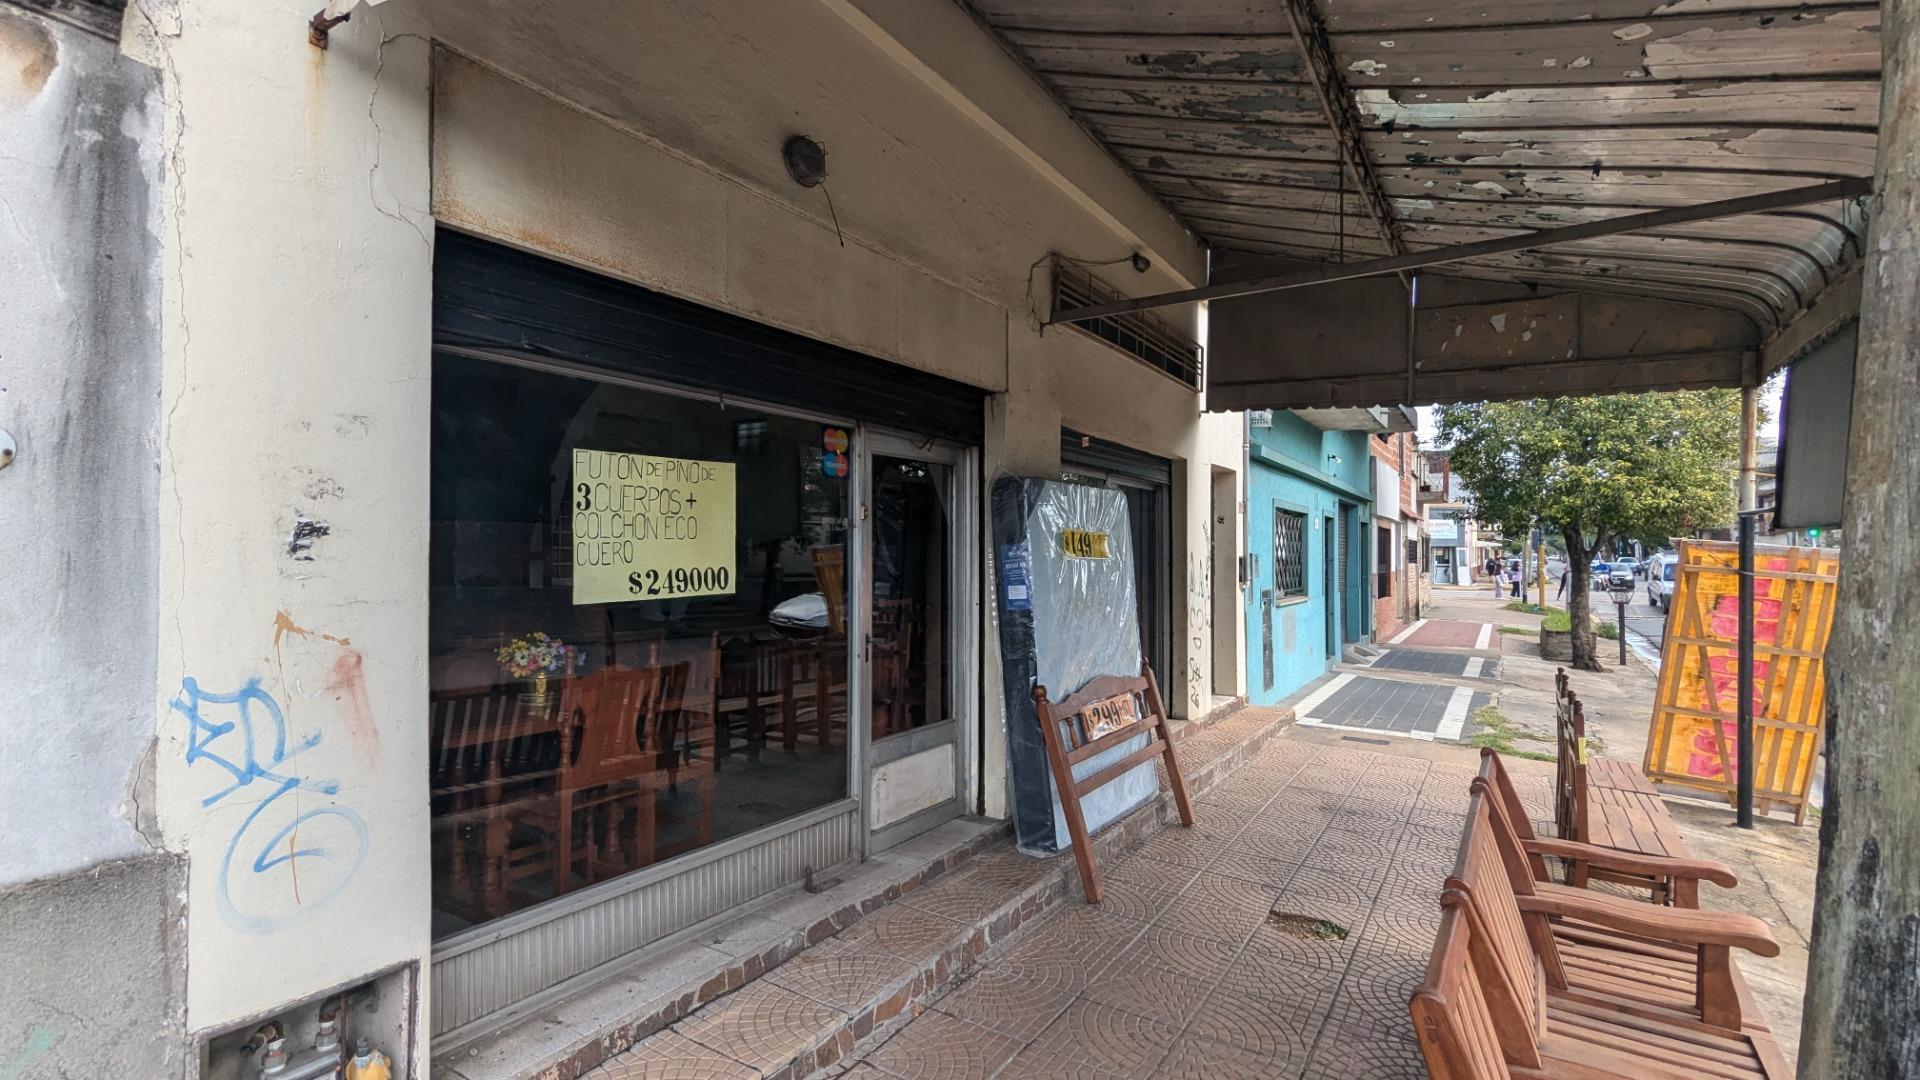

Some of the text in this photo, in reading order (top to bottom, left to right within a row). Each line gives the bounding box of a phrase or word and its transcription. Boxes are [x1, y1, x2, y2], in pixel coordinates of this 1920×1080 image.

[576, 450, 644, 480] FUTON
[647, 461, 662, 477] DE
[701, 466, 716, 482] DE
[576, 483, 697, 515] 3 CUERPOS +
[574, 512, 698, 541] COLCHON ECO
[576, 540, 634, 567] CUERO
